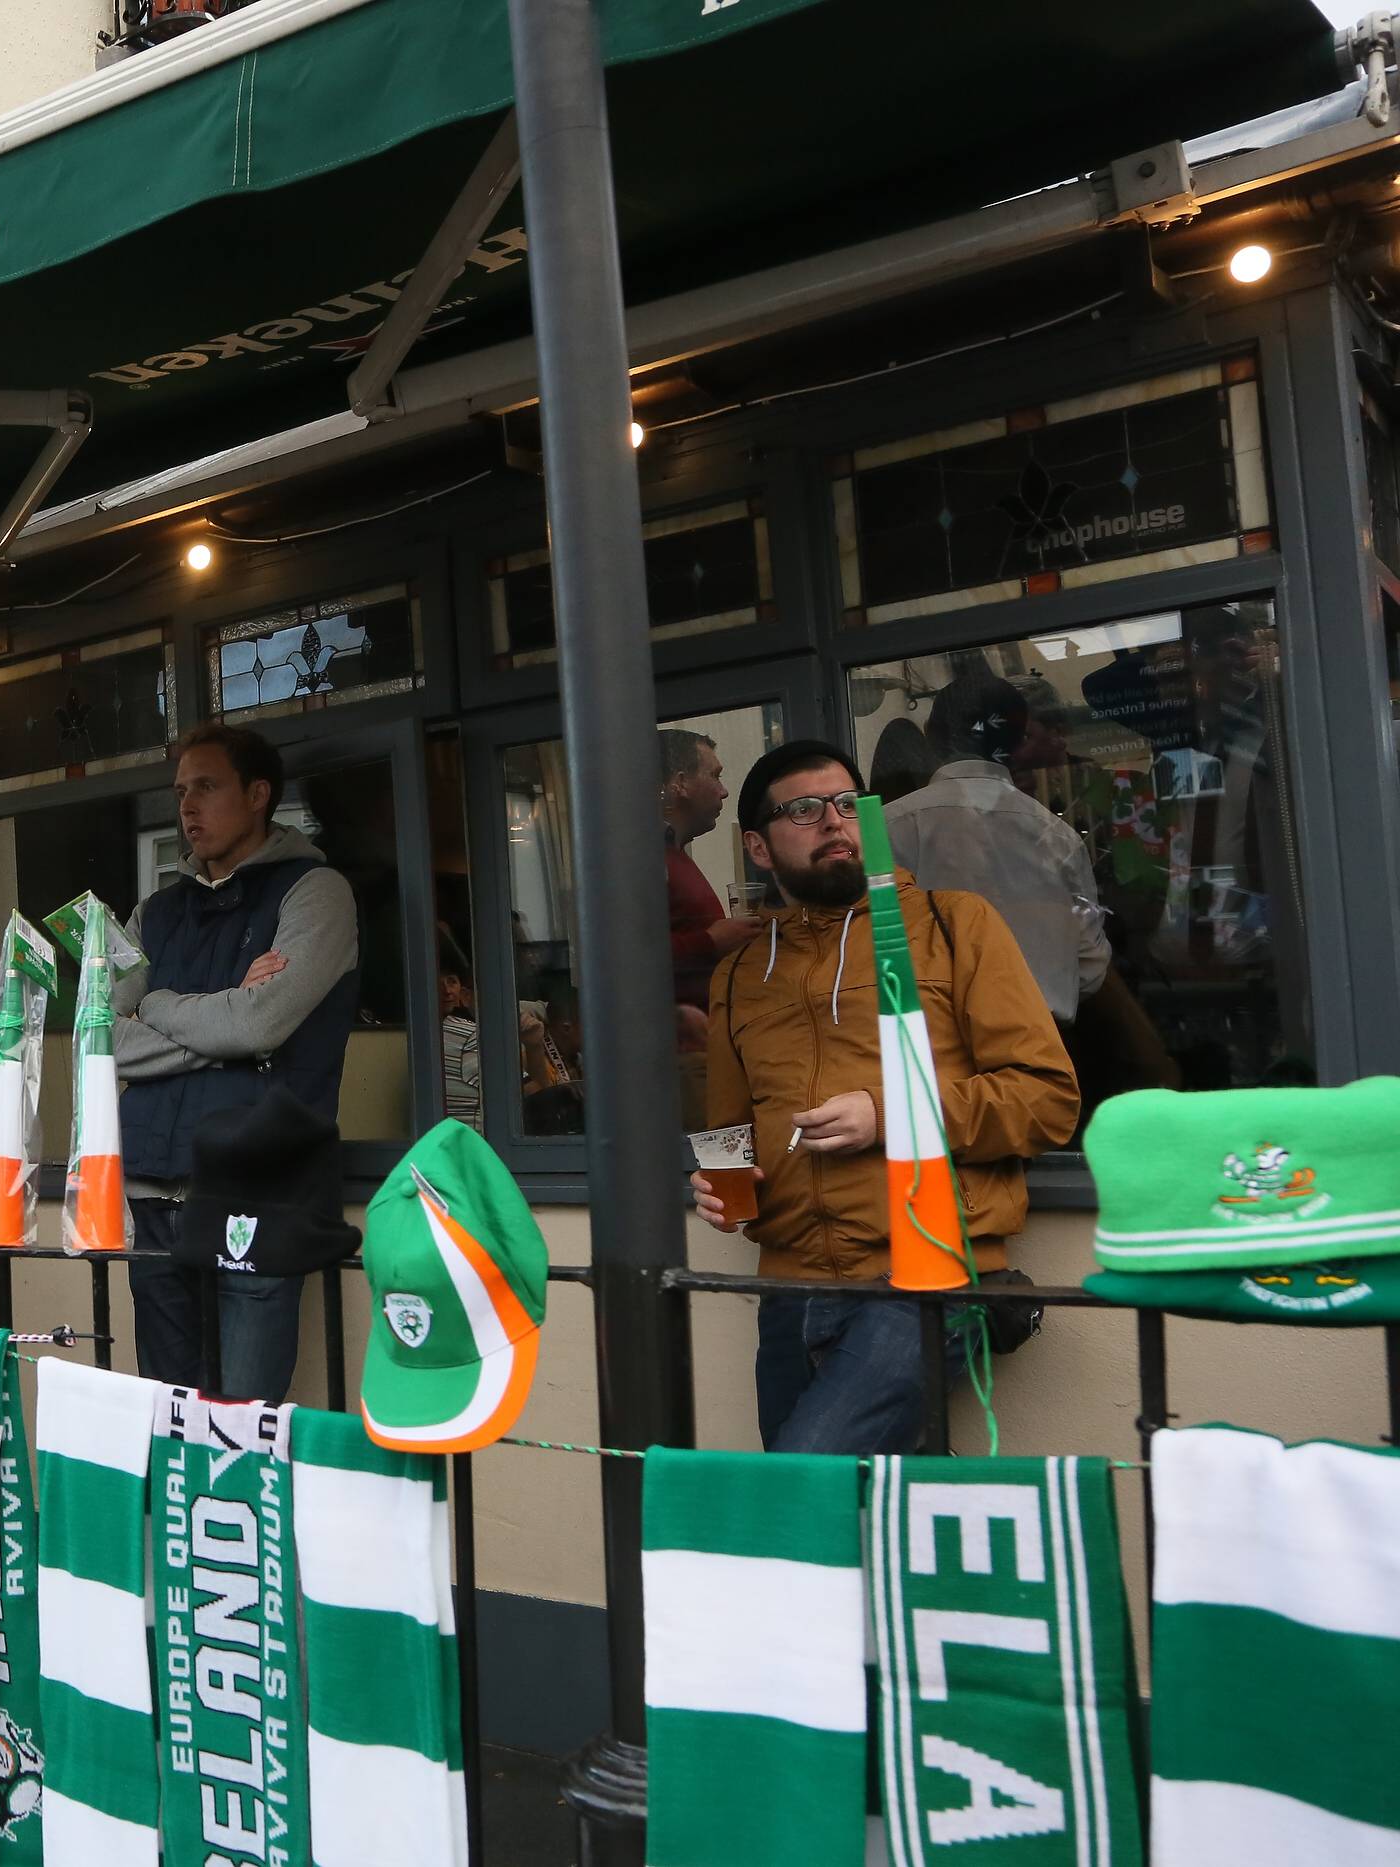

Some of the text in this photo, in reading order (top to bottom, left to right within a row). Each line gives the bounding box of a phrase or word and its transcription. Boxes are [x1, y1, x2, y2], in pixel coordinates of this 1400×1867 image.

[89, 227, 528, 385] Hineken
[0, 1457, 25, 1596] AVIVA
[167, 1586, 194, 1774] EUROPE
[191, 1494, 266, 1867] ELAND
[908, 1482, 1066, 1846] ELA
